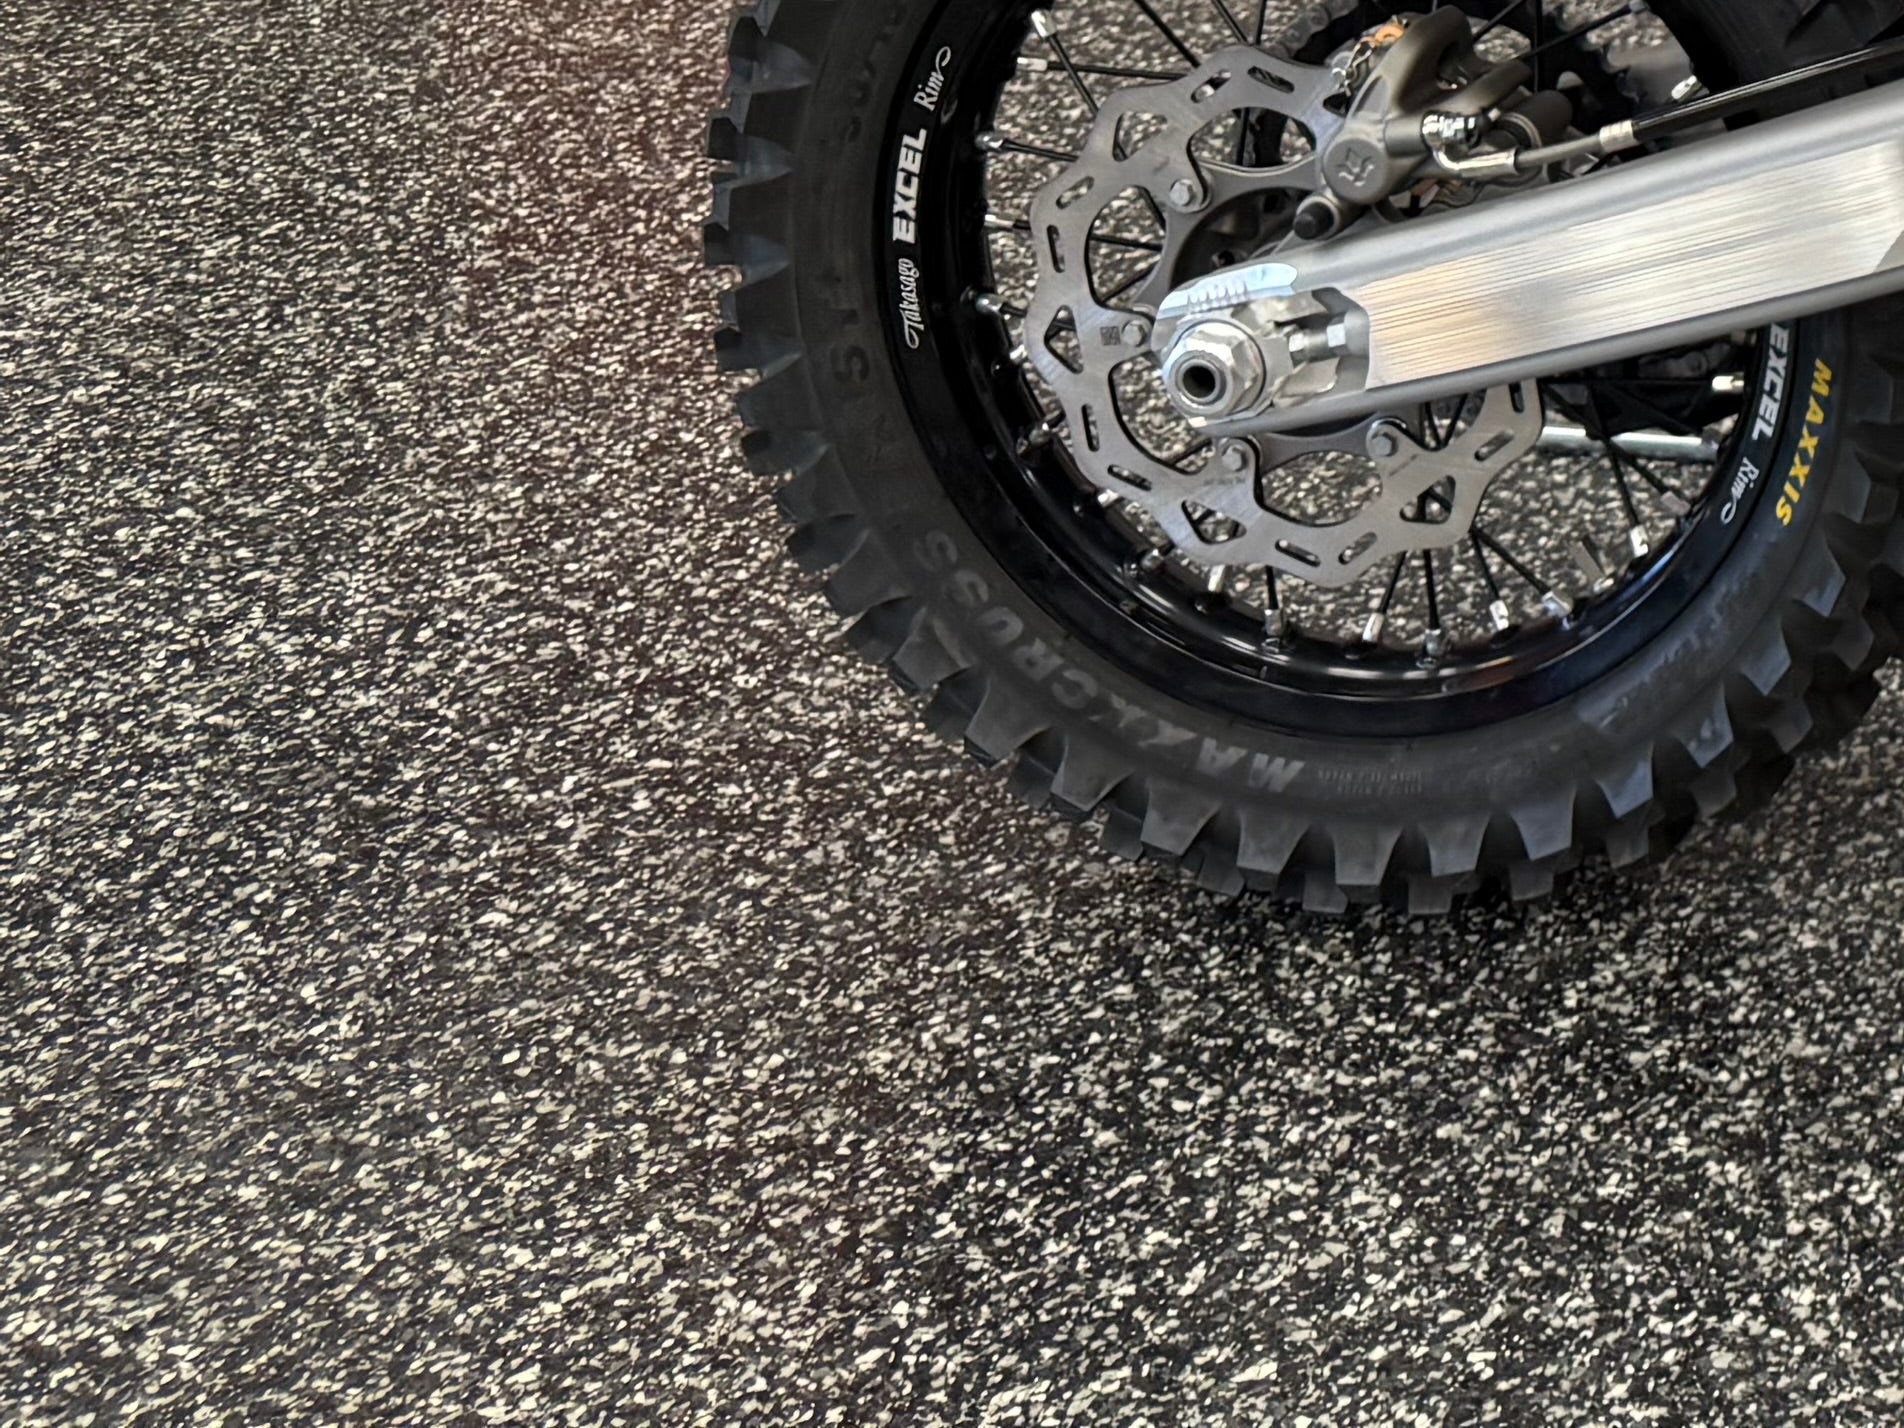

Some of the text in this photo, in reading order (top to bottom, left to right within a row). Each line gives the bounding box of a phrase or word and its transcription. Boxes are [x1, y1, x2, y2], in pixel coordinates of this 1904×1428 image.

[892, 46, 951, 350] Takasago EXCEL Rim
[1720, 322, 1790, 526] EXCEL Rim
[1775, 358, 1833, 527] MAXXIS
